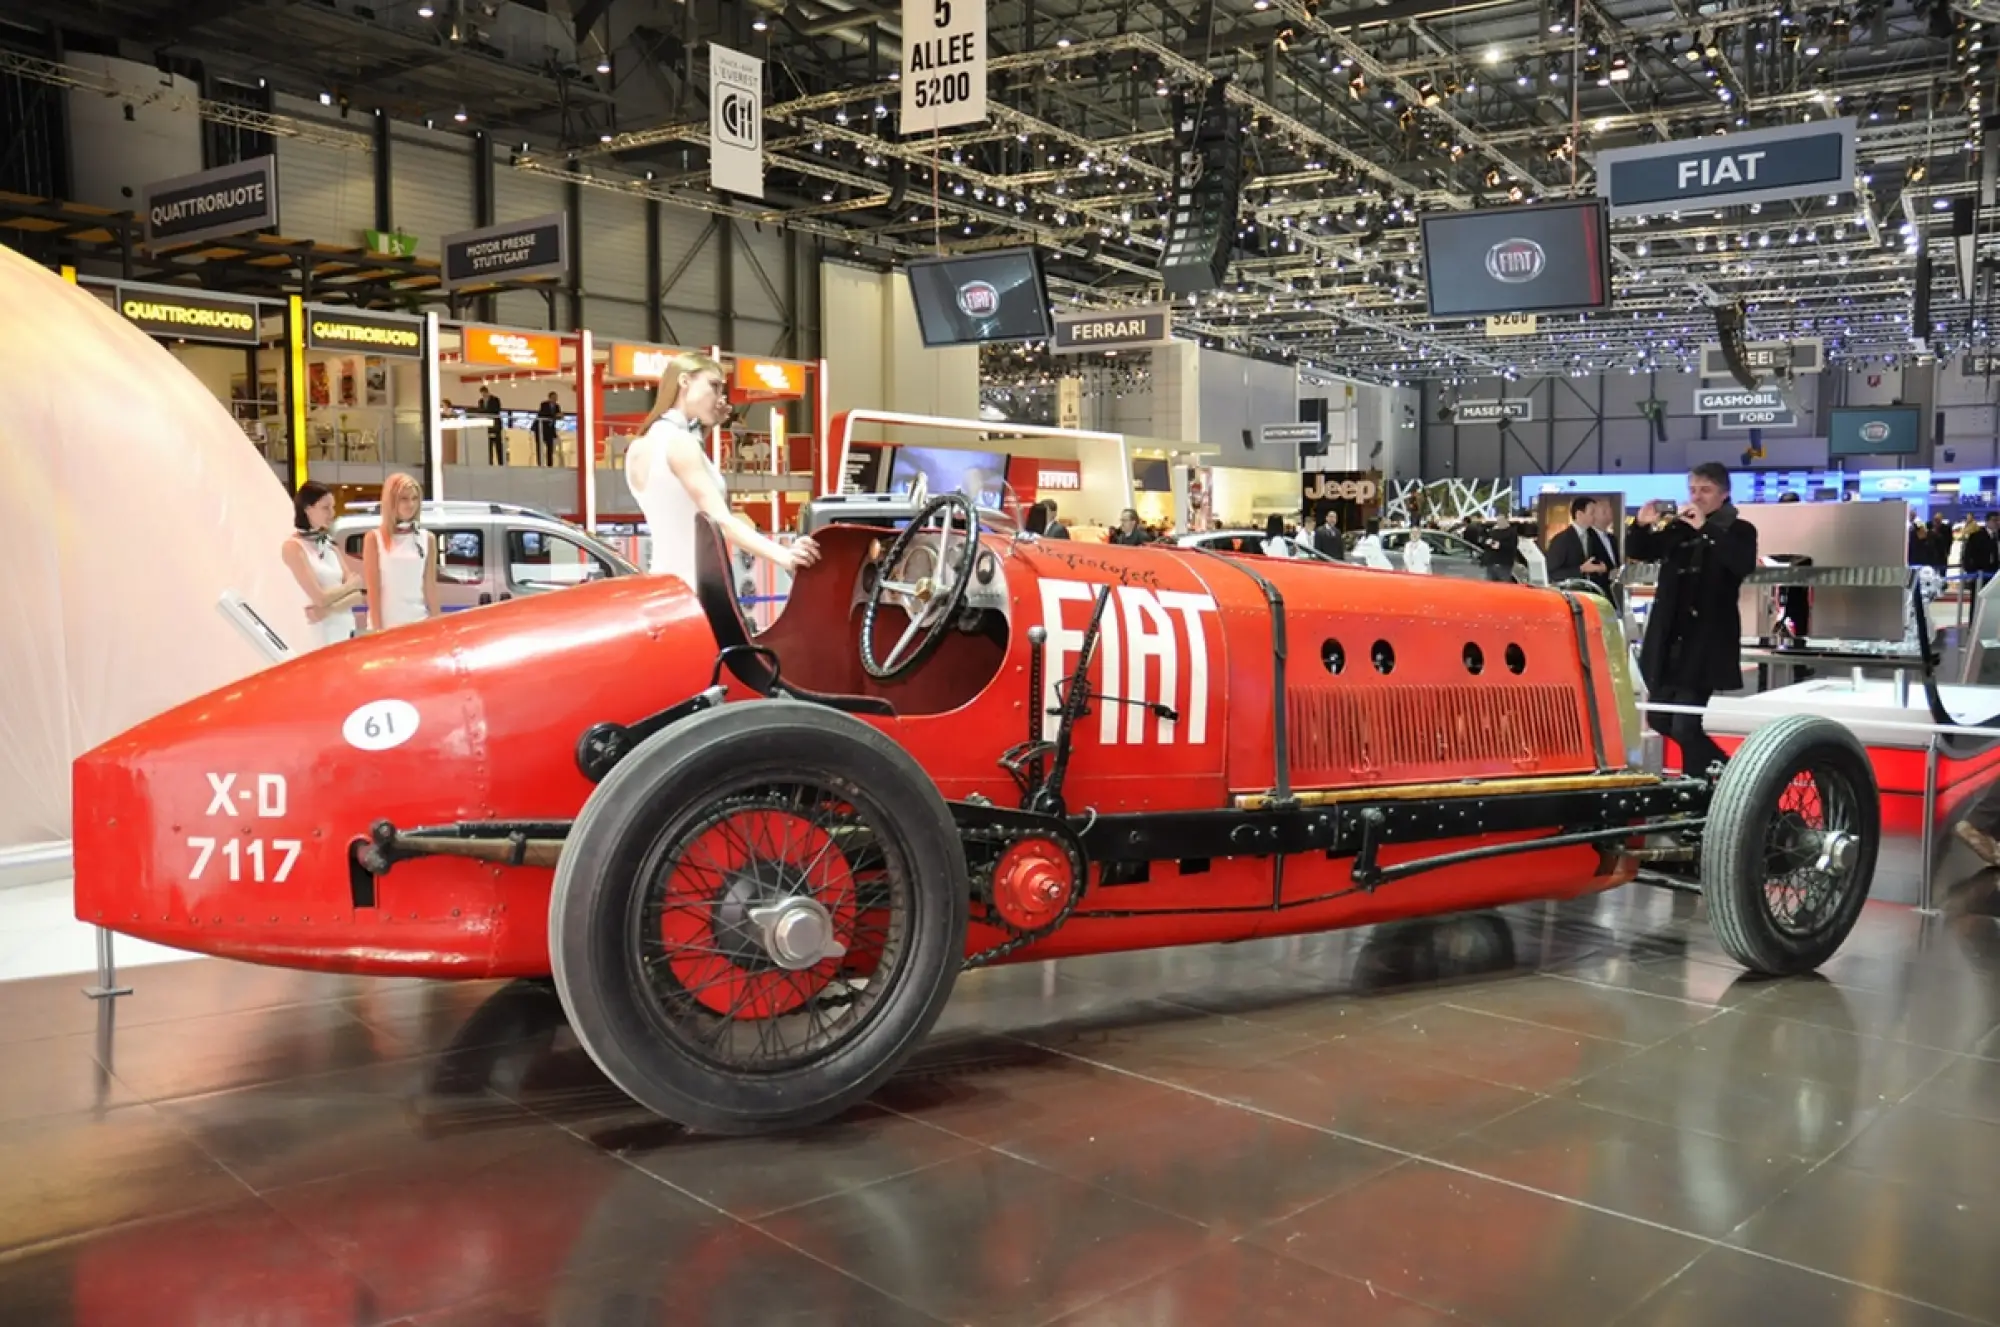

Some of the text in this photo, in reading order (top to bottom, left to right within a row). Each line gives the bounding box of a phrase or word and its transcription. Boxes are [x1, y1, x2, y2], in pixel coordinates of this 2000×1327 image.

[934, 0, 951, 28] 5
[911, 32, 974, 73] ALLEE
[914, 71, 970, 108] 5200
[1678, 151, 1766, 189] FIAT
[151, 183, 265, 226] QUATTRORUOTE
[466, 233, 537, 258] MOTOR PRESSE
[472, 249, 530, 270] STUTTGART
[1499, 251, 1533, 272] FIAT
[1071, 319, 1146, 341] FERRARI
[1703, 393, 1777, 408] GASMOBIL
[1739, 411, 1775, 423] FORD
[1304, 474, 1375, 504] Jeep
[1037, 577, 1217, 744] FIAT
[364, 711, 394, 738] 61
[205, 772, 287, 817] X-D
[186, 836, 302, 883] 7117
